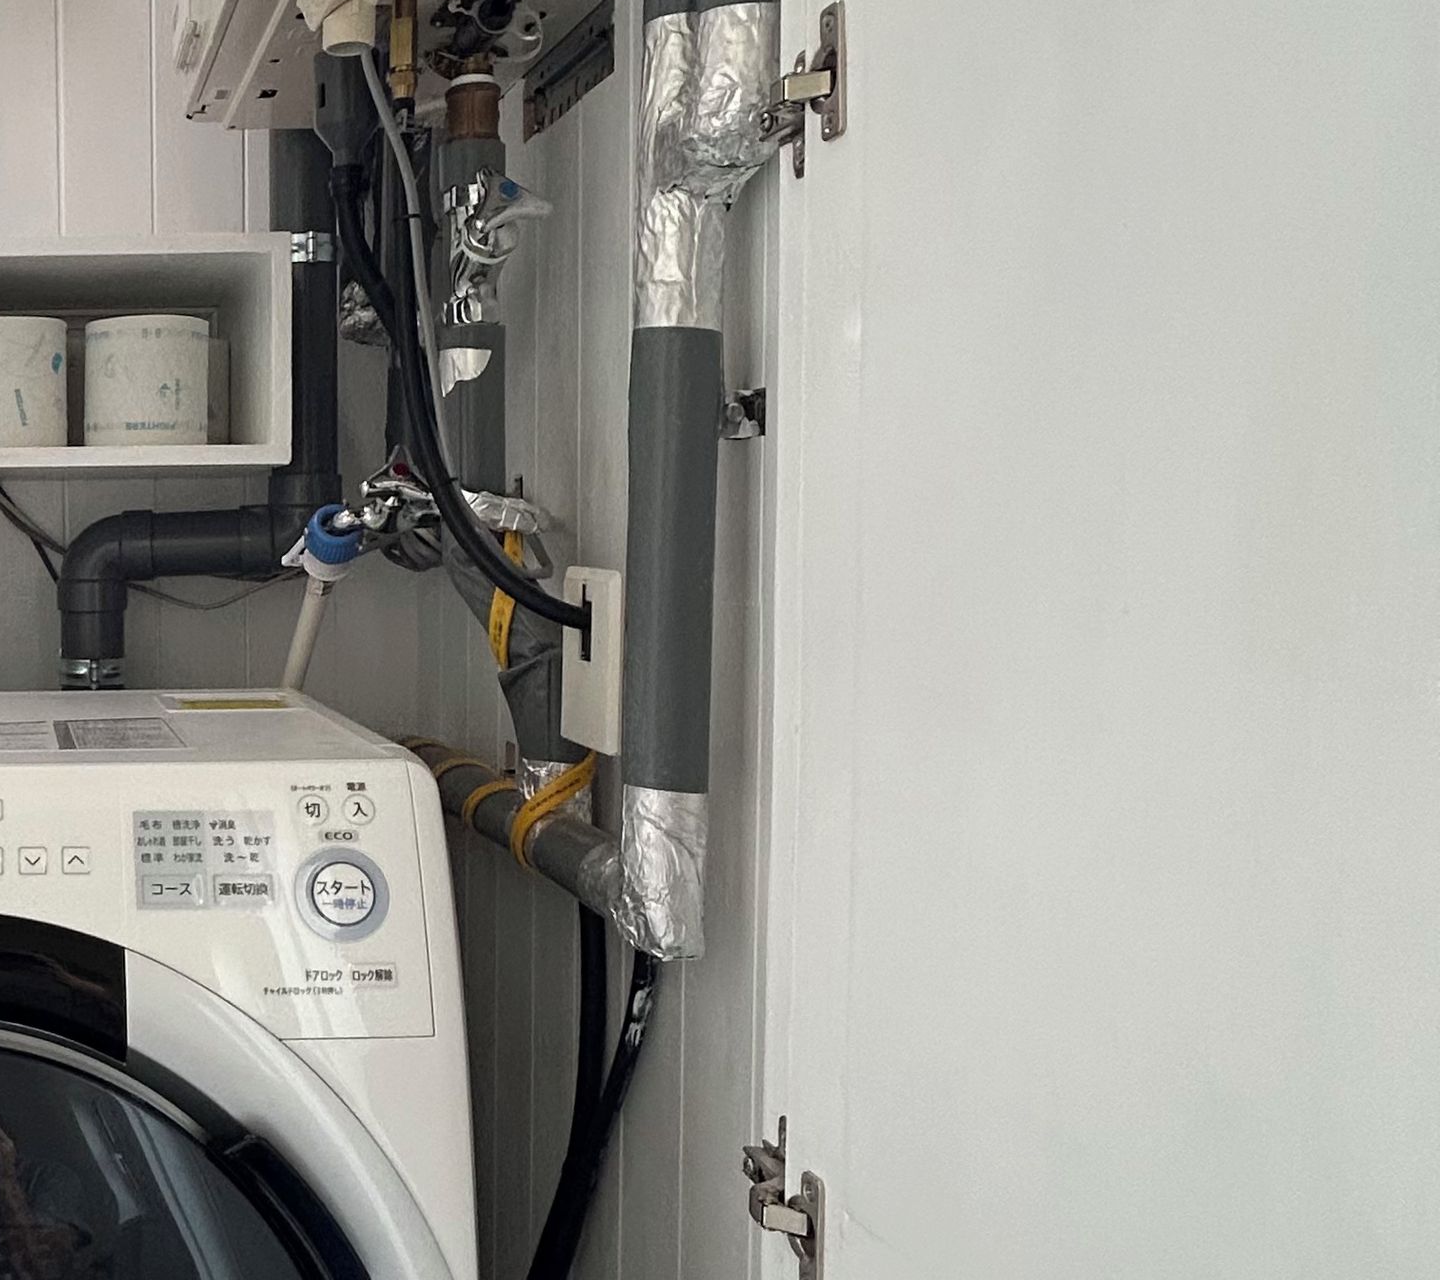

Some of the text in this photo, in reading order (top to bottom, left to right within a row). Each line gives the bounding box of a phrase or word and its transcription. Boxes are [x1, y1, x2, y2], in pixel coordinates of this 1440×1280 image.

[304, 802, 321, 818] 切
[352, 802, 368, 817] 入
[324, 831, 353, 841] ECO
[151, 883, 192, 896] コース
[316, 880, 371, 895] スタート
[305, 969, 343, 981] ドアロック
